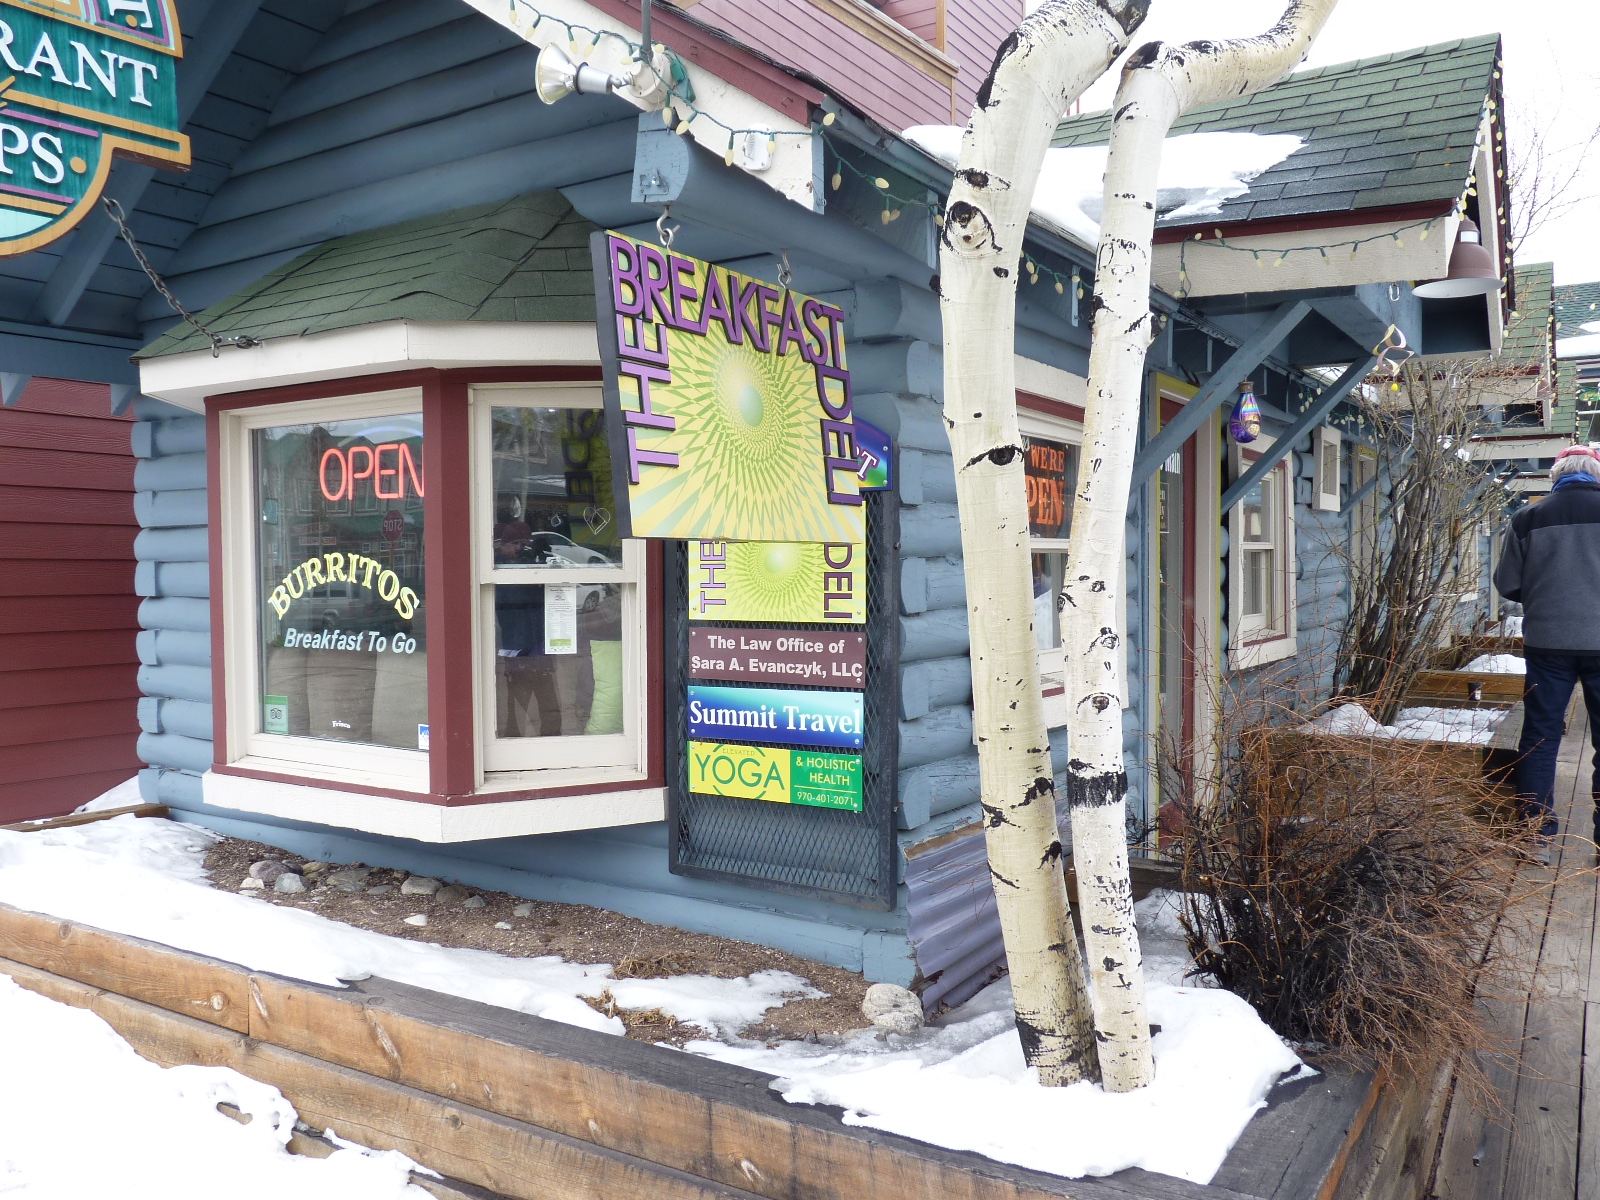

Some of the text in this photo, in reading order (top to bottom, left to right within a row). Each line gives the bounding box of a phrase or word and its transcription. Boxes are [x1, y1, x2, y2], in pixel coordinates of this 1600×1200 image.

[608, 235, 844, 372] BREAKFAST
[616, 314, 680, 485] THE
[815, 364, 863, 506] DELI
[319, 443, 425, 501] OPEN
[1030, 444, 1065, 473] WE'RE
[1024, 475, 1065, 526] PEN
[268, 552, 420, 620] BURRITOS
[700, 540, 726, 613] THE
[824, 543, 853, 619] DELI
[284, 628, 417, 654] Breakfast To Go
[707, 635, 846, 654] The Law Office of
[691, 655, 863, 678] Sara A. Evanczyk, LLC
[690, 700, 862, 734] Summit Travel
[722, 748, 756, 756] ELEVATED
[796, 757, 856, 772] & HOLISTIC
[695, 753, 785, 791] YOGA
[809, 773, 850, 786] HEALTH
[797, 791, 855, 806] 970-401-2071
